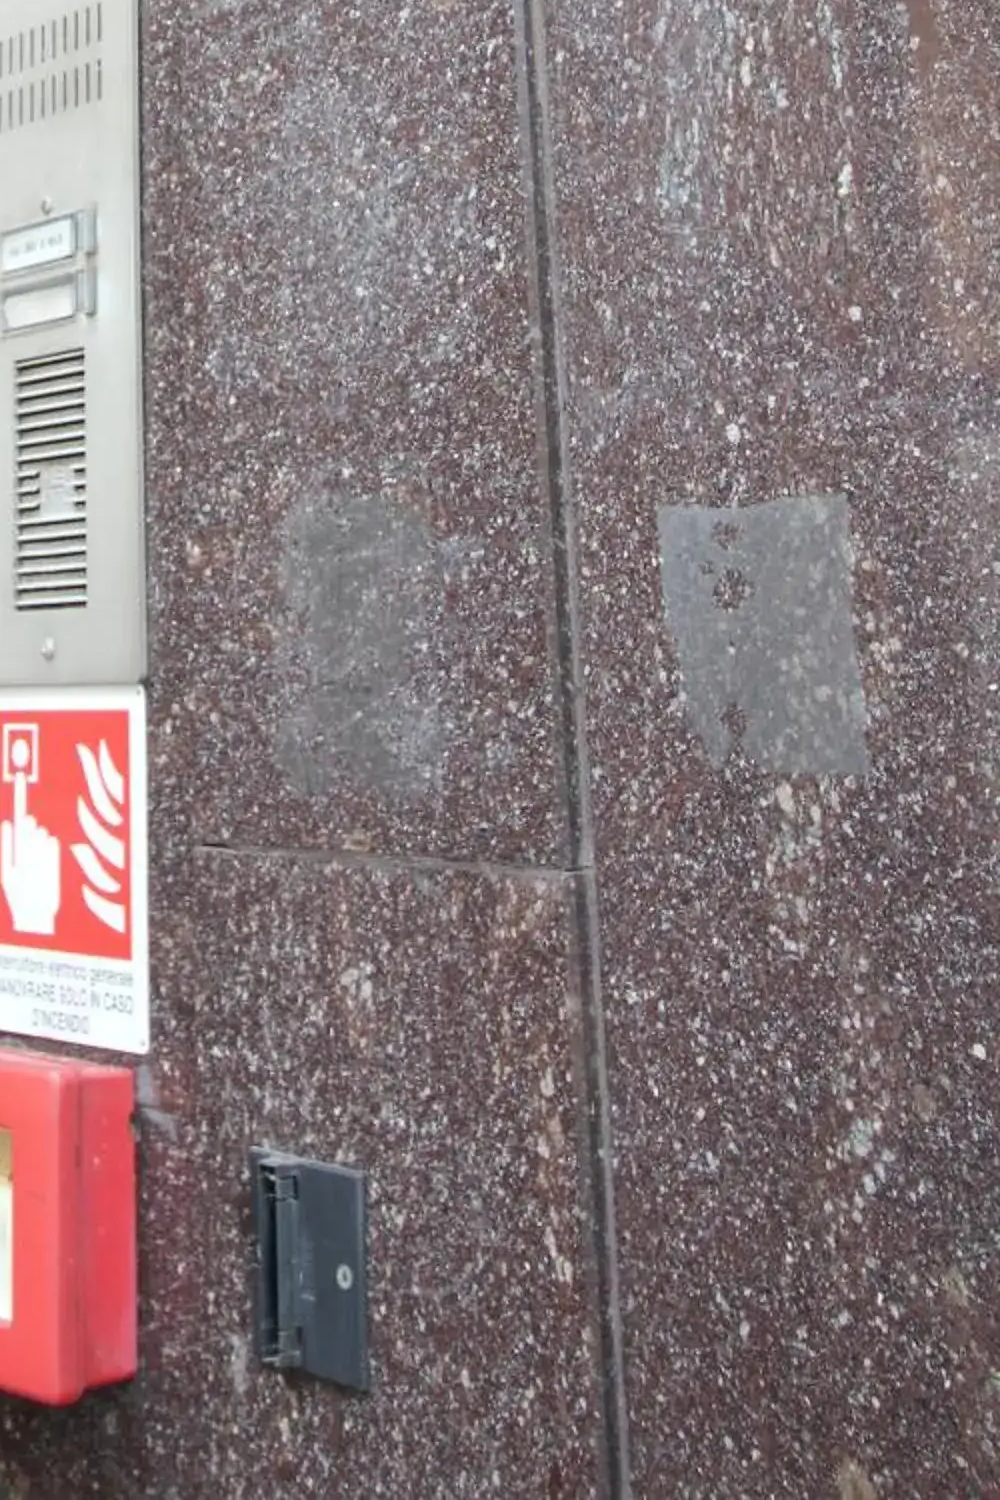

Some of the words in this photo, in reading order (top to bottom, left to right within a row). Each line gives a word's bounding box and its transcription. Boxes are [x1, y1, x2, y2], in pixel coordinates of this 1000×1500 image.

[59, 983, 88, 1007] SOLO
[90, 989, 101, 1009] IN
[103, 991, 135, 1016] CASO
